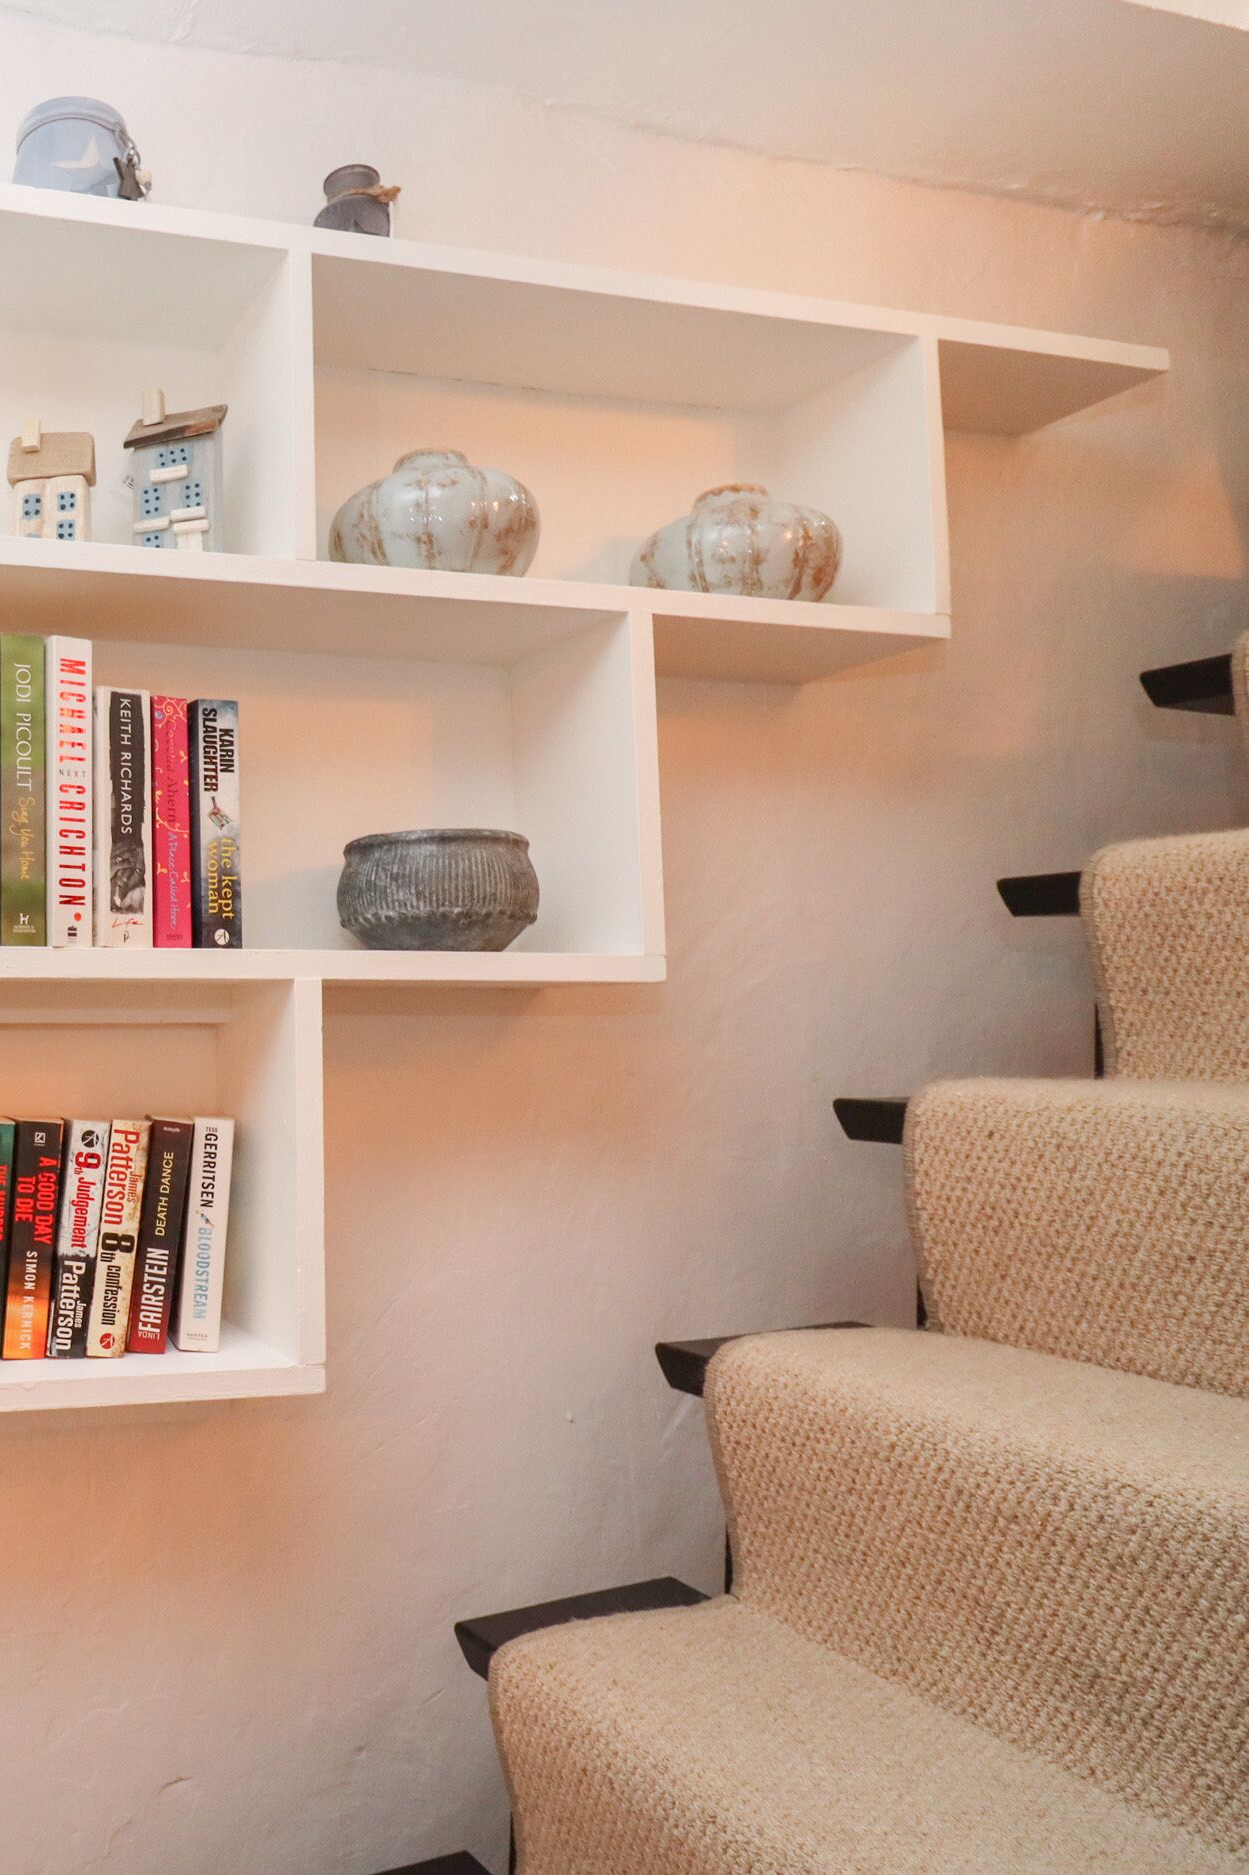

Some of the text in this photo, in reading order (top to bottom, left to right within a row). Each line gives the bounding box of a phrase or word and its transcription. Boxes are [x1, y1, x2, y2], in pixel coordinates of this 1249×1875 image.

[14, 663, 32, 791] JODI PICOULT
[59, 658, 87, 762] MICHAEL
[59, 769, 86, 777] NEXT
[120, 698, 132, 834] KEITH RICHARDS
[202, 707, 218, 792] SLAUGHTER
[219, 728, 235, 773] KARIN
[9, 797, 35, 880] Sing You Home
[59, 784, 86, 906] CRICHTON
[207, 843, 219, 914] woman
[222, 875, 238, 919] kept
[36, 1172, 57, 1211] GOOD
[39, 1157, 59, 1167] A
[104, 1129, 140, 1225] Patterson
[127, 1171, 143, 1203] James
[155, 1152, 174, 1237] DEATH DANCE
[200, 1132, 218, 1208] GERRITSEN
[15, 1177, 36, 1222] TO DIE
[33, 1215, 54, 1244] DAY
[71, 1177, 96, 1249] Judgement
[20, 1251, 38, 1349] SIMON KERNICK
[55, 1260, 86, 1350] Patterson
[101, 1265, 122, 1325] confession
[139, 1248, 169, 1333] FAIRSTEIN
[193, 1227, 212, 1319] BLOODSTREAM
[74, 1301, 86, 1328] James
[138, 1331, 160, 1340] LINDA
